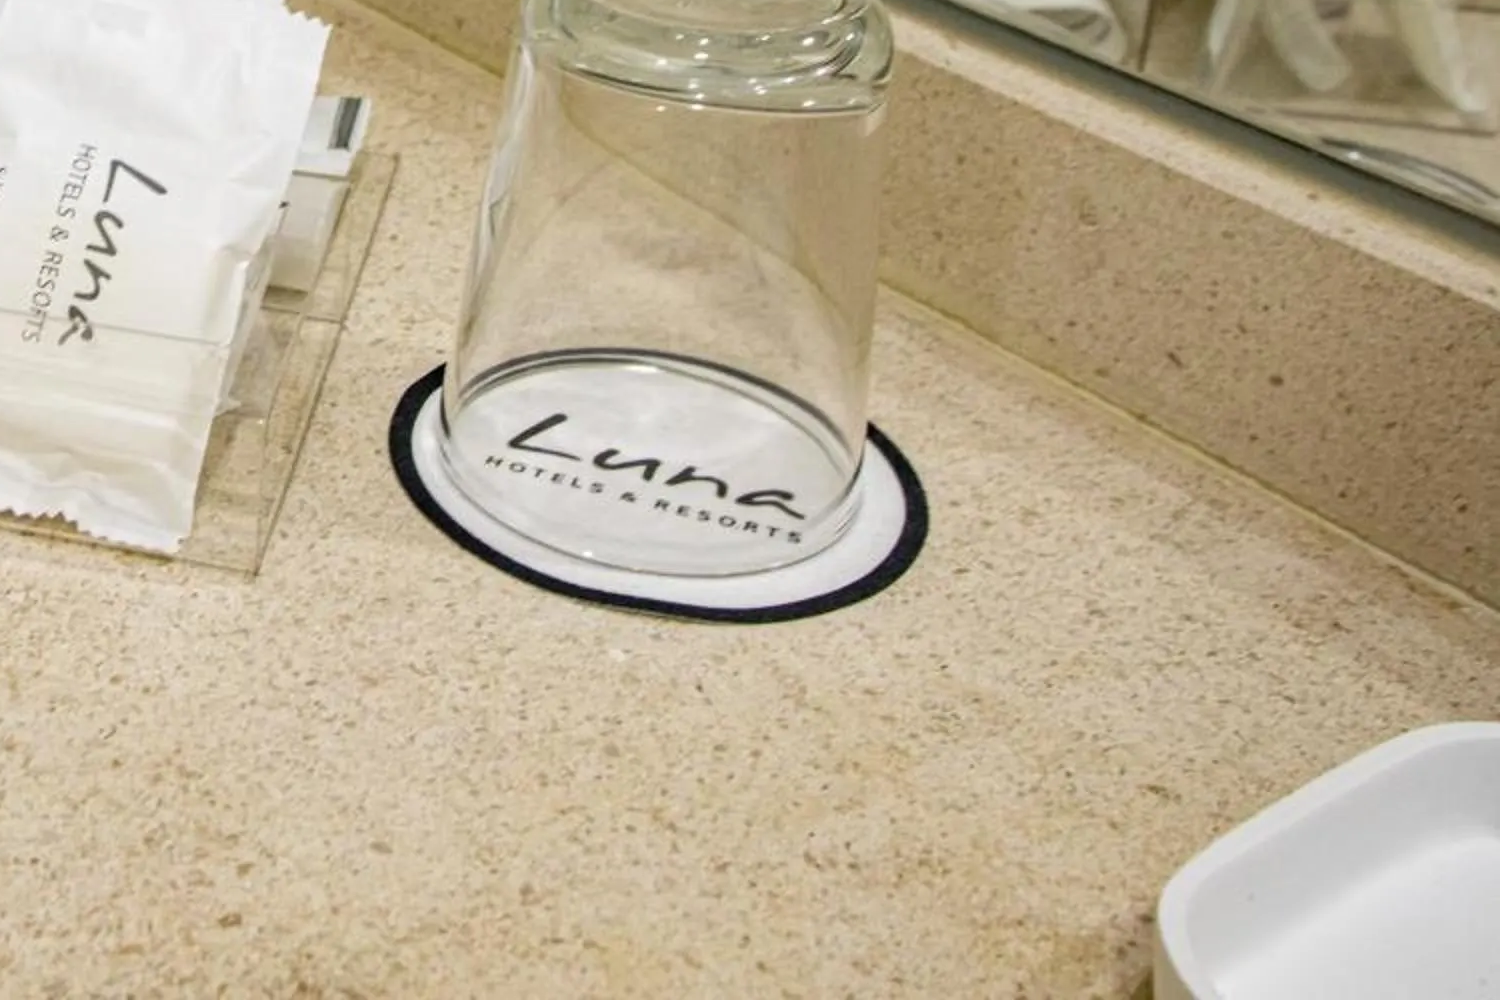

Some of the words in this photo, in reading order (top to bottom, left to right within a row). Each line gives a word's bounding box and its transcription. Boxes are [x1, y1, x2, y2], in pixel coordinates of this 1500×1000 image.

[56, 142, 98, 220] HOTELS
[49, 225, 70, 242] &
[58, 159, 168, 346] Luna
[20, 249, 64, 344] RESORTS
[484, 456, 605, 495] HOTELS
[619, 491, 637, 504] &
[654, 497, 804, 544] RESORTS
[507, 413, 806, 520] Luna
